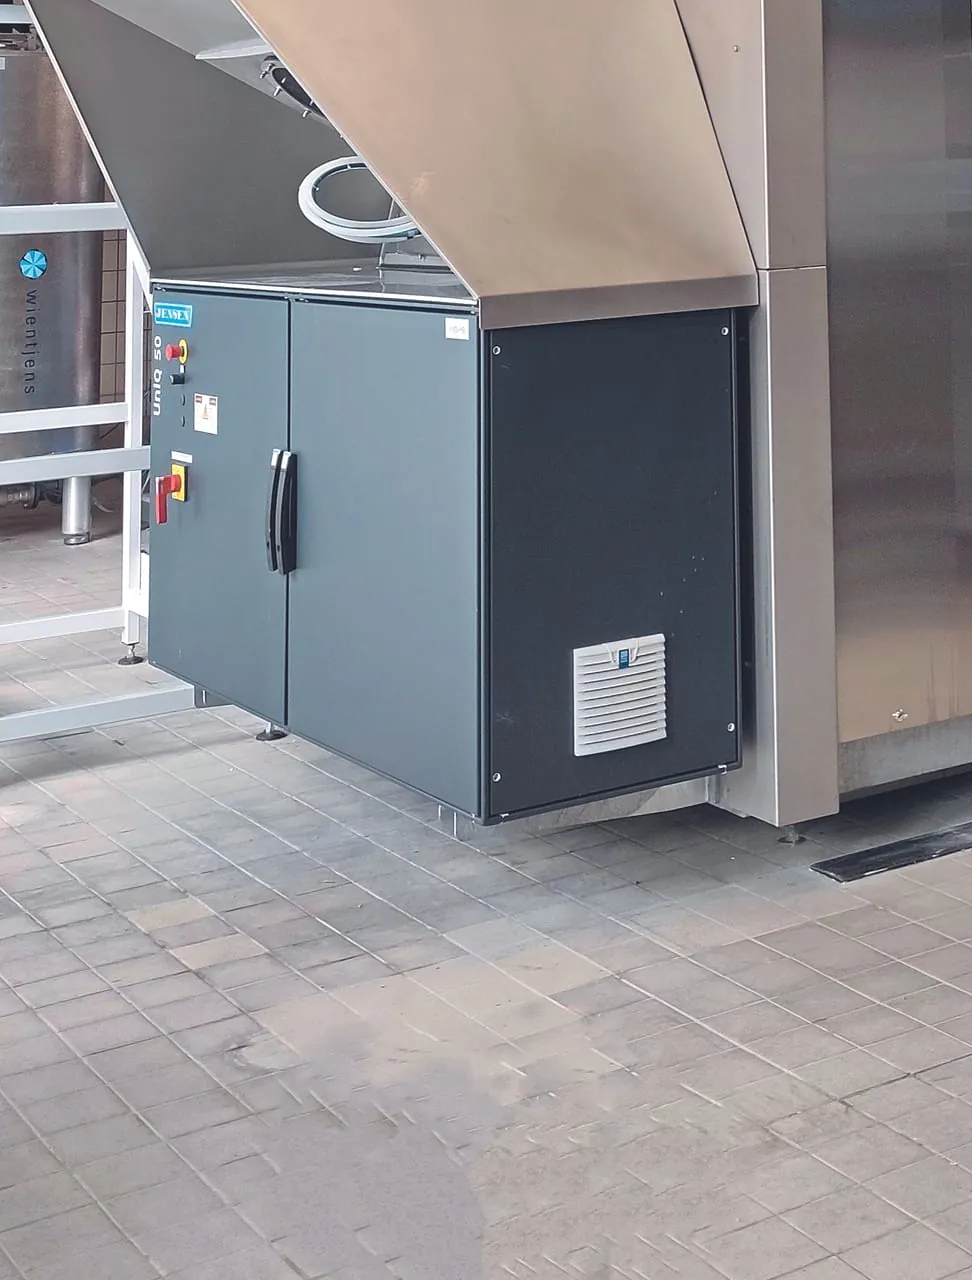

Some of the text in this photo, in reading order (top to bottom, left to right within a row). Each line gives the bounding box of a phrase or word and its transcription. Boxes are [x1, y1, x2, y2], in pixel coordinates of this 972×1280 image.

[21, 289, 40, 394] wientjens
[155, 307, 190, 321] JENSEN
[153, 335, 162, 416] UniQ 50
